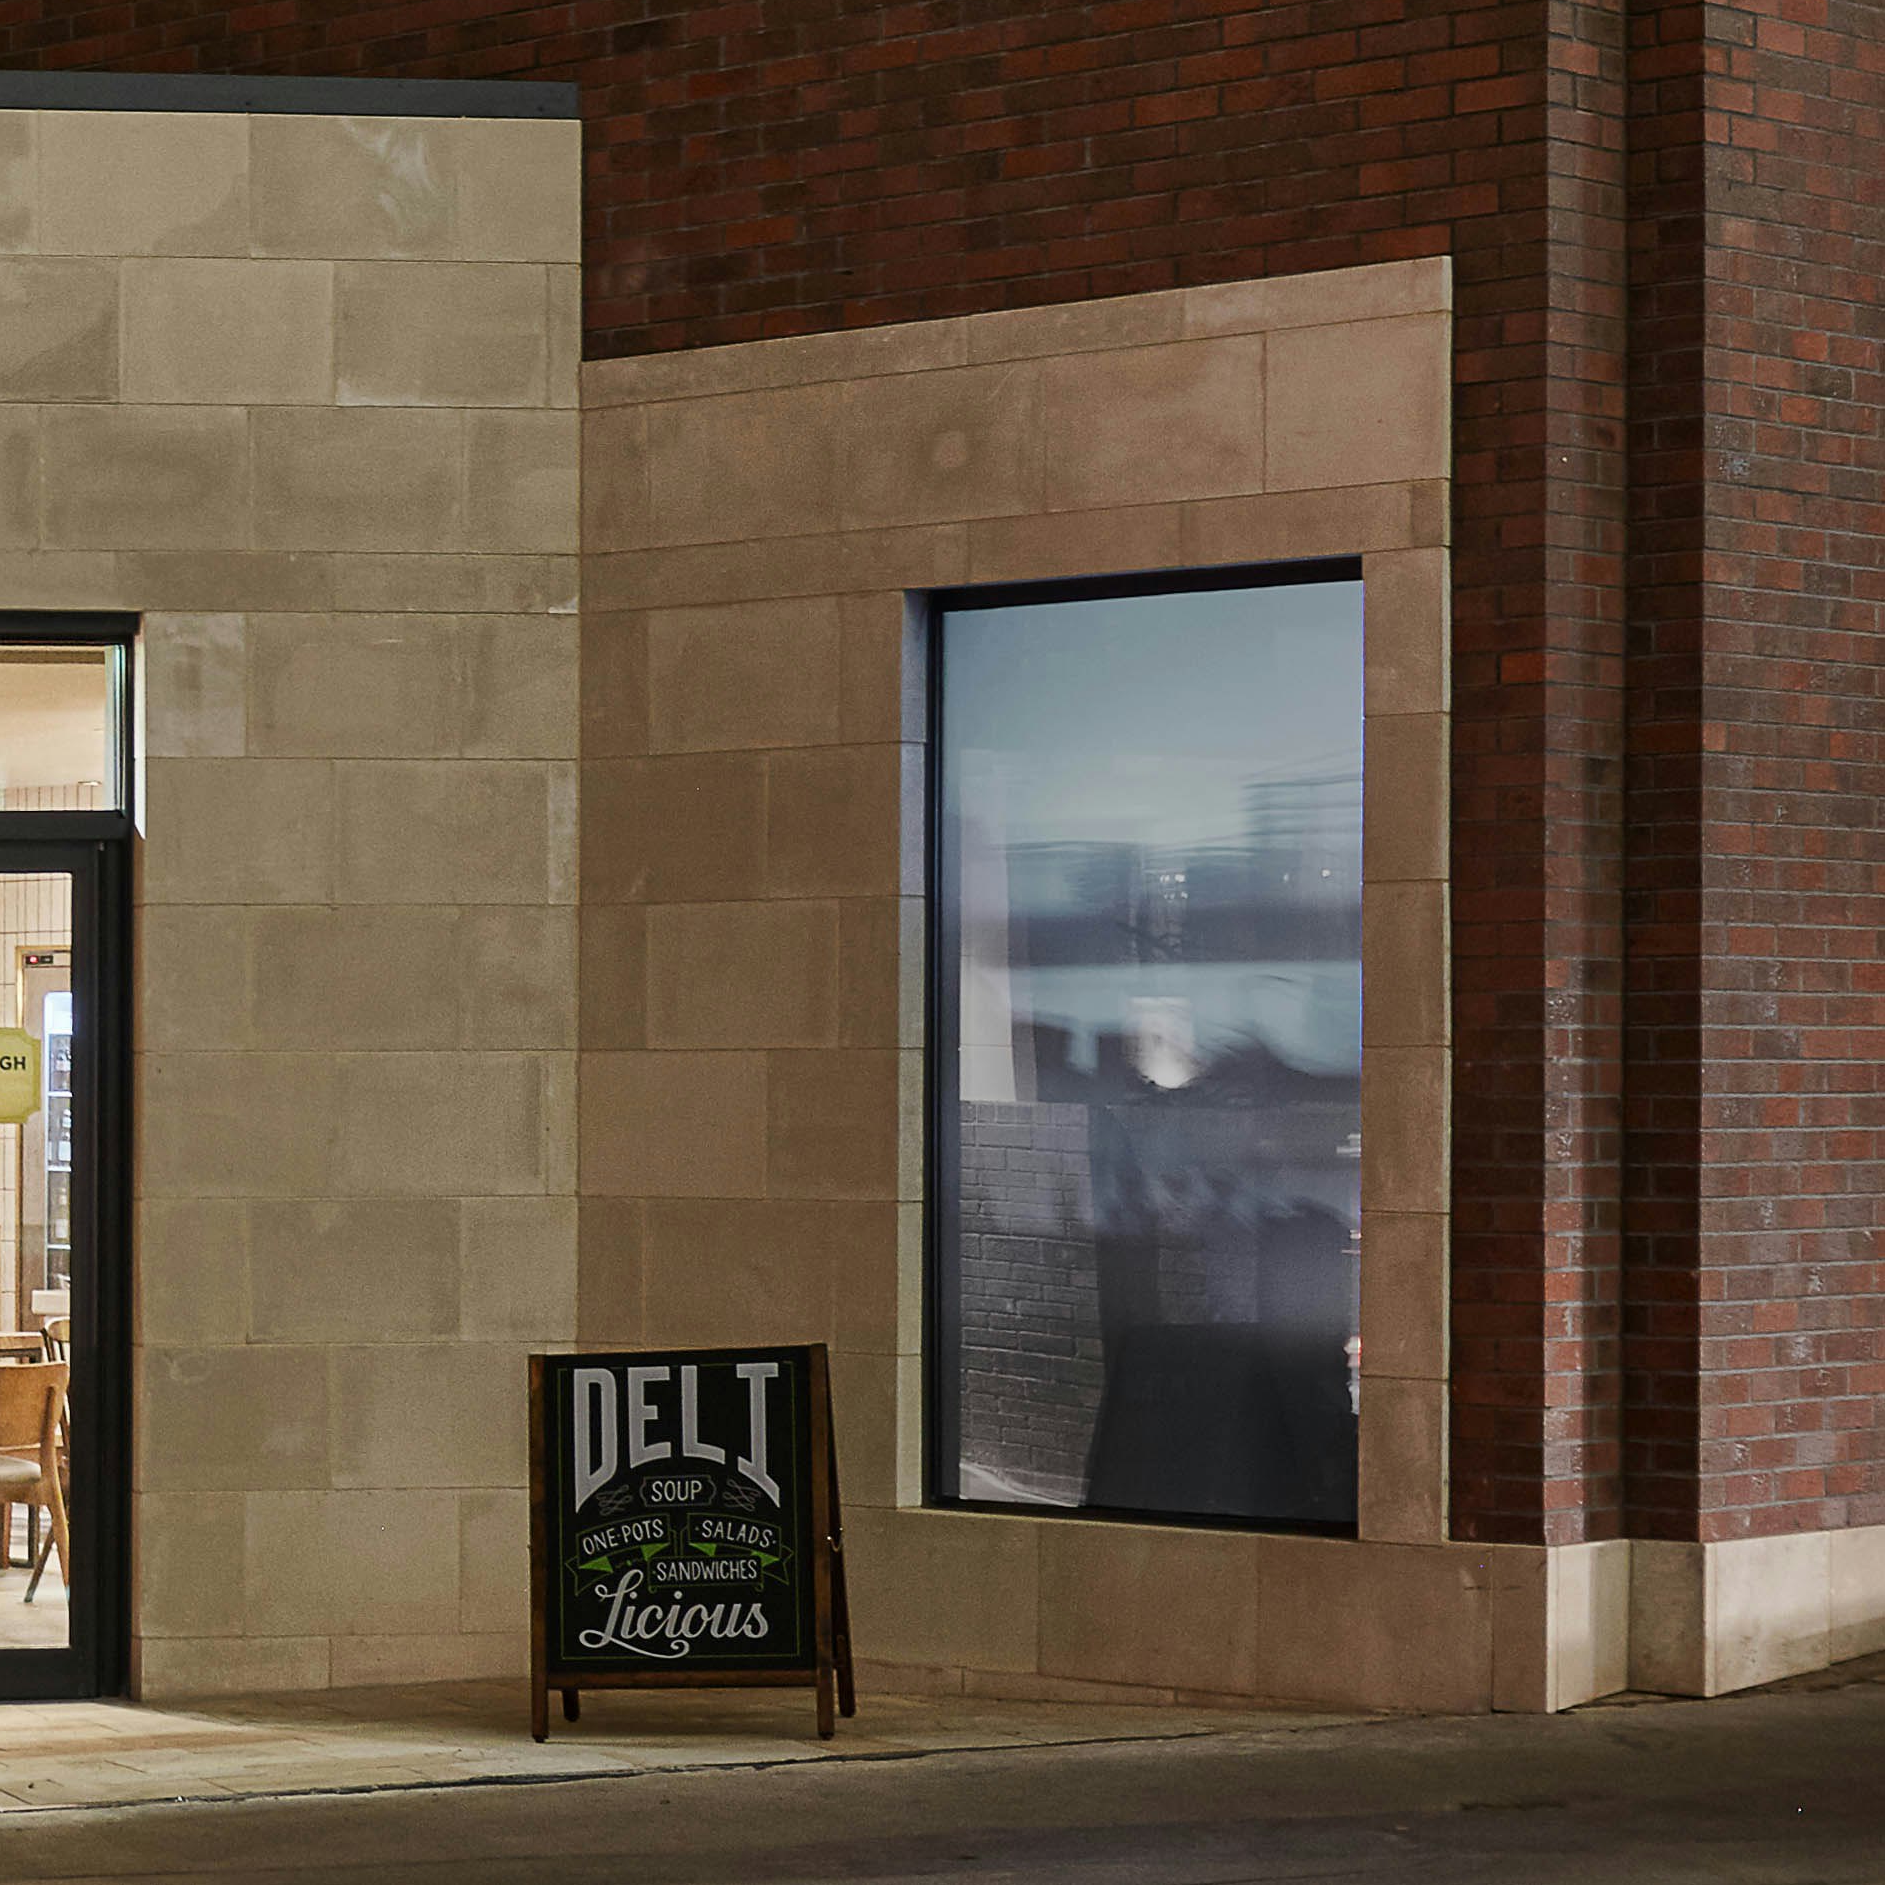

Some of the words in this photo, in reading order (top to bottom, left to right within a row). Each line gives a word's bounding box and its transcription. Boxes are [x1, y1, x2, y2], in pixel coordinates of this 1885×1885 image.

[573, 1361, 780, 1514] DELI
[650, 1479, 703, 1502] SOUP
[656, 1559, 758, 1582] SANDWICHES
[579, 1568, 769, 1659] Licious
